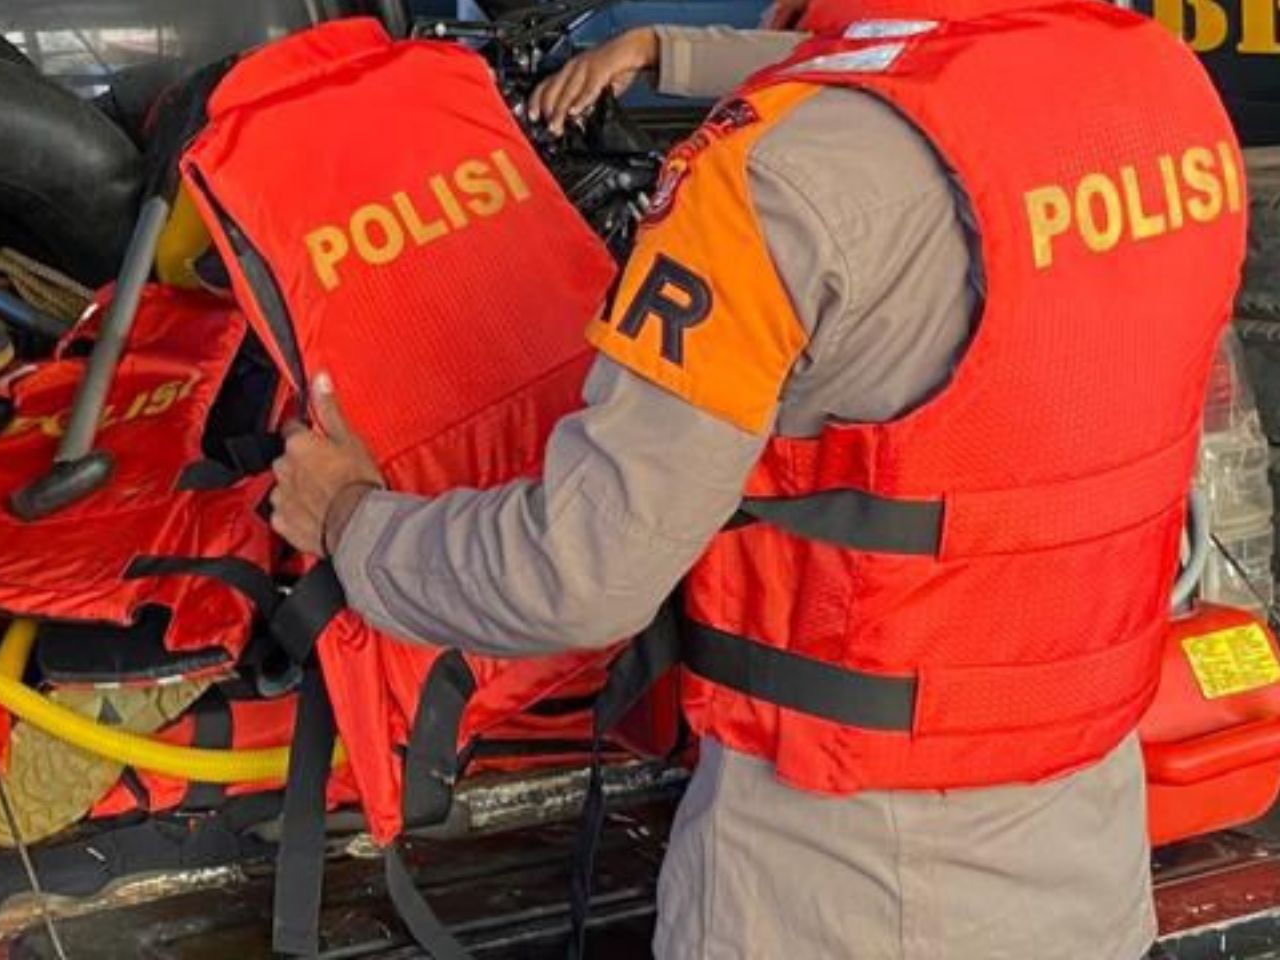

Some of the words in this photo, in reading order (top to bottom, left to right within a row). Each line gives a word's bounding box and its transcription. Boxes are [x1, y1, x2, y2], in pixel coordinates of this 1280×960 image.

[304, 148, 531, 291] POLISI
[1024, 140, 1242, 270] POLISI
[601, 251, 714, 368] R
